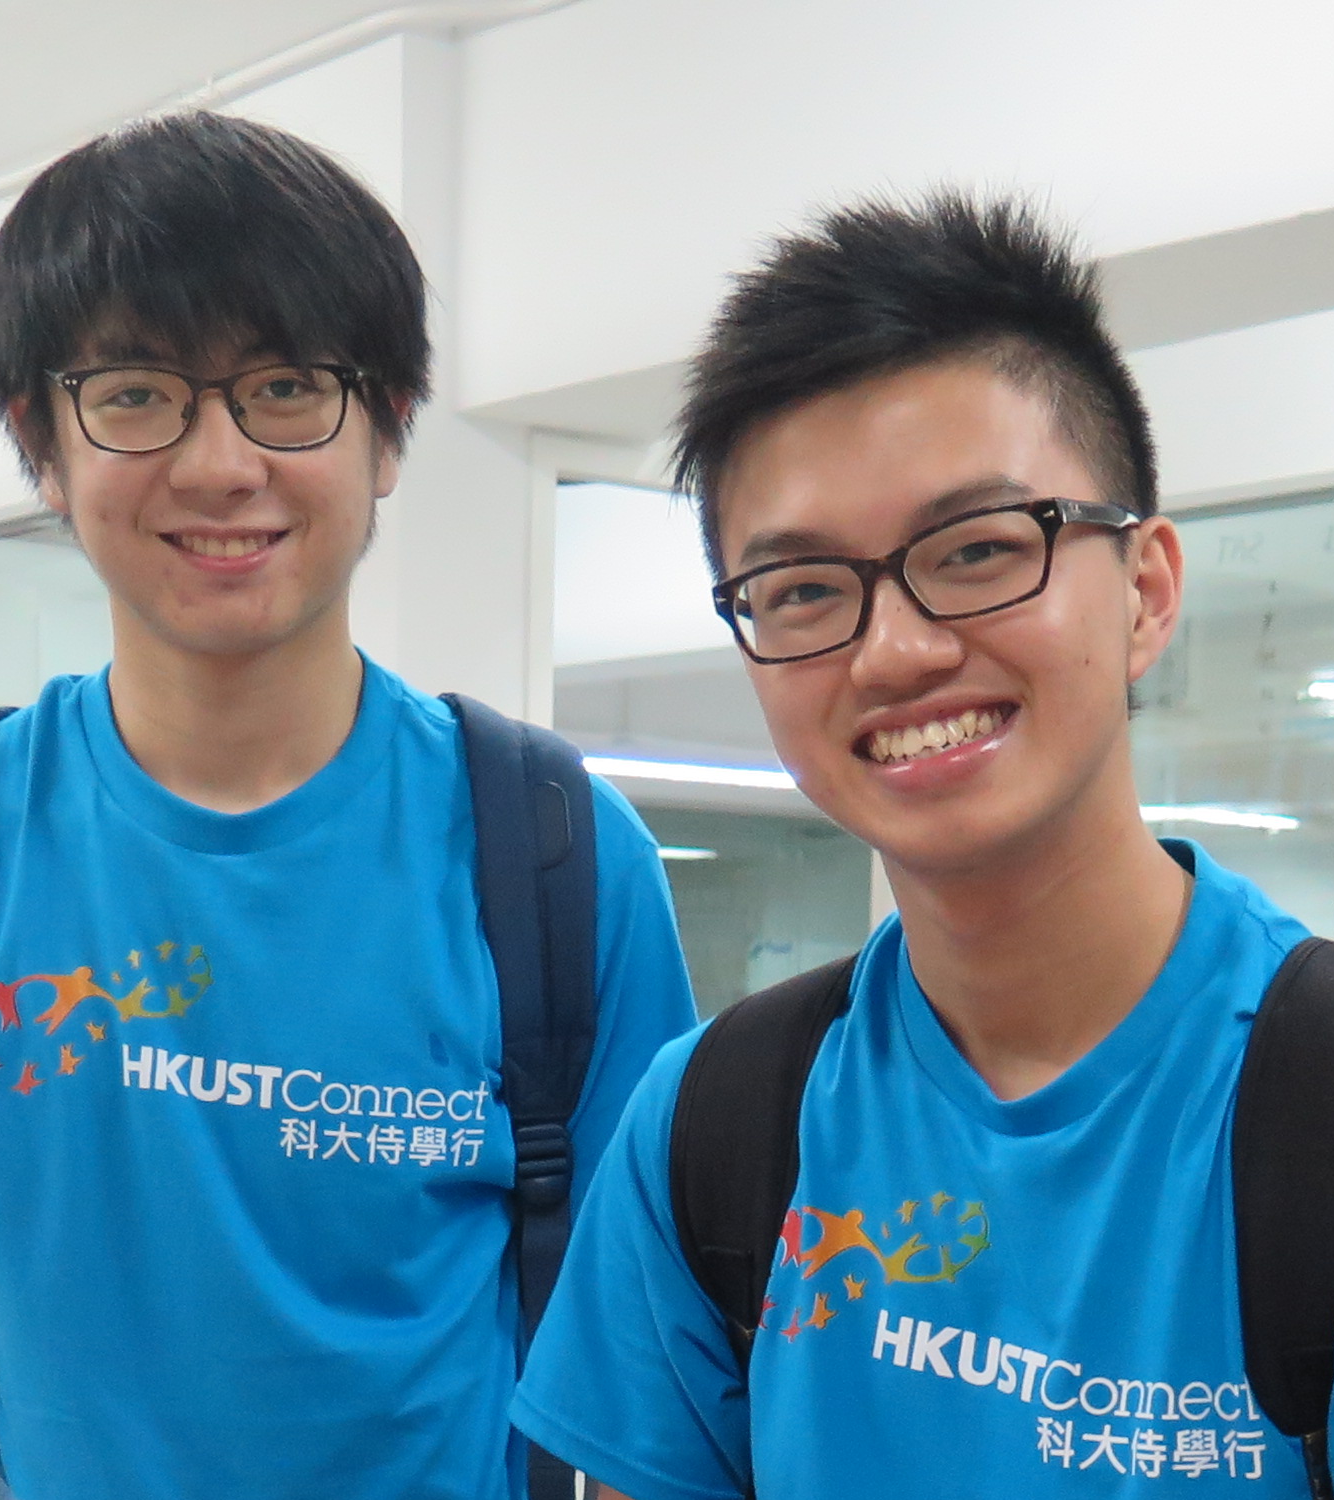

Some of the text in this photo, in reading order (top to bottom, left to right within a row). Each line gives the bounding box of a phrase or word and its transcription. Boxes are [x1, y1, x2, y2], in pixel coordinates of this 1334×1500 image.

[121, 1042, 489, 1122] HKUSTConnect
[279, 1117, 486, 1169] 科大侍學行
[1035, 1416, 1269, 1481] 科大侍學行
